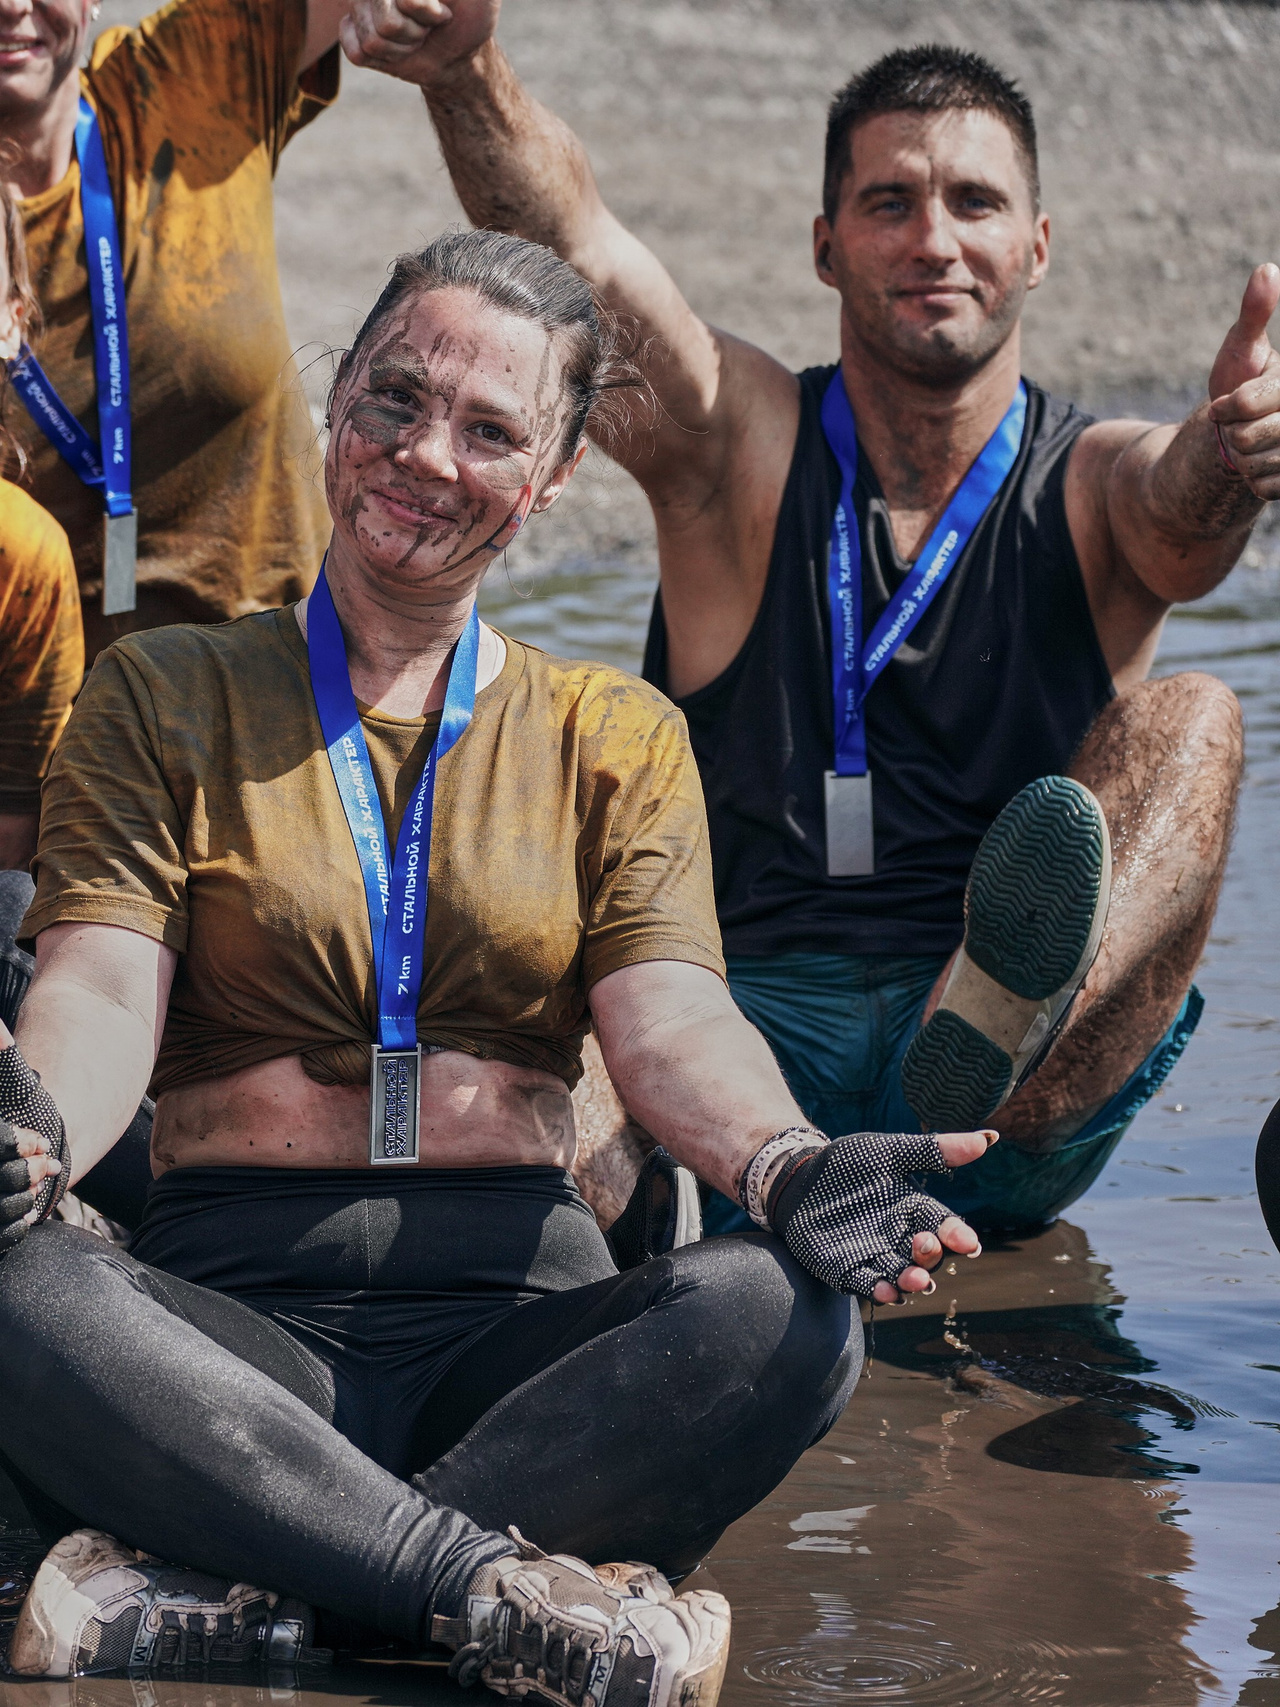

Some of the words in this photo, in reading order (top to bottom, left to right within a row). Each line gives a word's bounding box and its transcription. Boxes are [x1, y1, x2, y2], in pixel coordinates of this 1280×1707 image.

[98, 236, 117, 320] ХАРАКТЕР
[103, 323, 122, 407] СТАЛЬНОЙ
[837, 587, 854, 672] СТАЛЬНОЙ
[864, 599, 918, 672] СТАЛЬНОЙ
[913, 530, 959, 601] ХАРАКТЕР
[342, 737, 375, 822] ХАРАКТЕР
[402, 841, 420, 934] СТАЛЬНОЙ
[397, 983, 409, 996] 7
[399, 955, 412, 979] km
[383, 1059, 397, 1156] СТАЛЬНОЙ
[396, 1059, 409, 1155] ХАРАКТЕР
